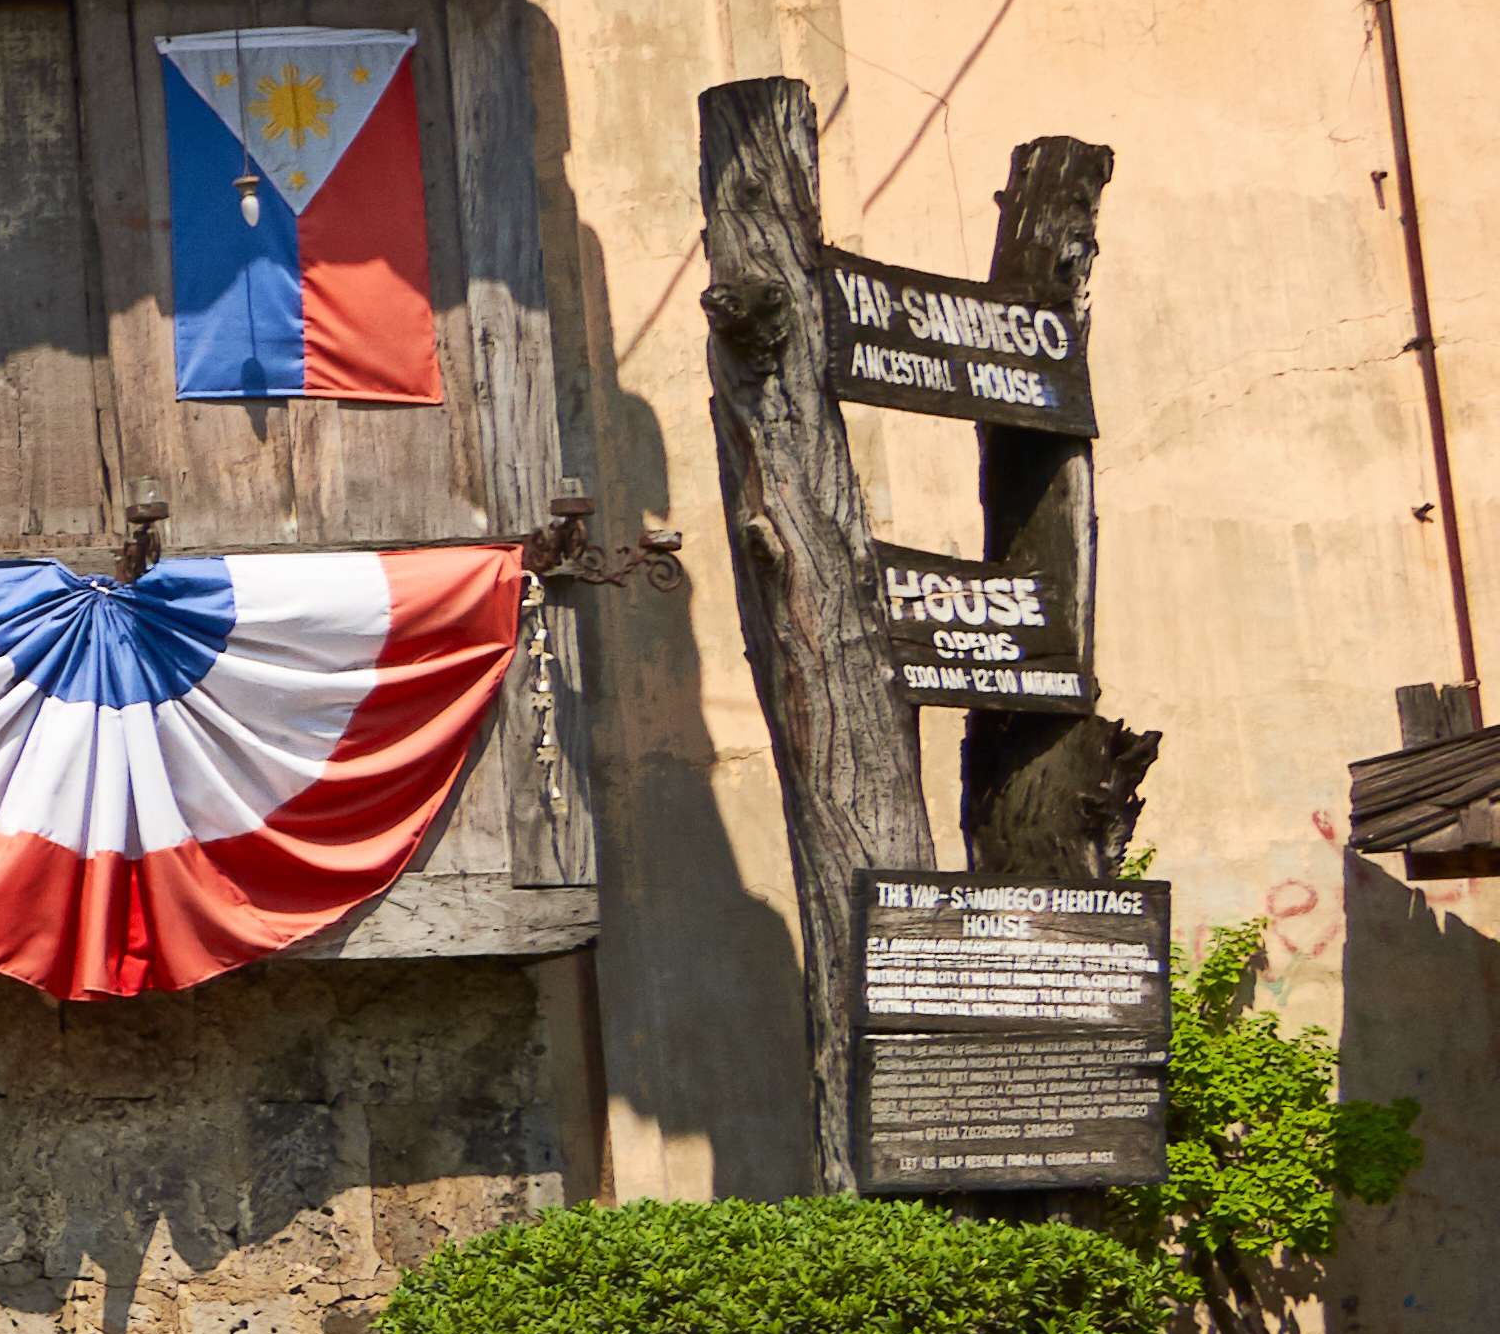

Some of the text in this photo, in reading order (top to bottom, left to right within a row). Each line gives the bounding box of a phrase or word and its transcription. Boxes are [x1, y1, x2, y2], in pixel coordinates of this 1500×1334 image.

[834, 268, 1068, 361] YAP-SANDIEGO
[851, 342, 1045, 407] ANCESTRAL HOUSE
[885, 567, 1045, 626] HOUSE
[933, 630, 1020, 660] OPENS
[876, 882, 1143, 915] THE YAP-SANDIEGO HERITAGE
[962, 914, 1031, 938] HOUSE
[900, 1156, 917, 1170] LET
